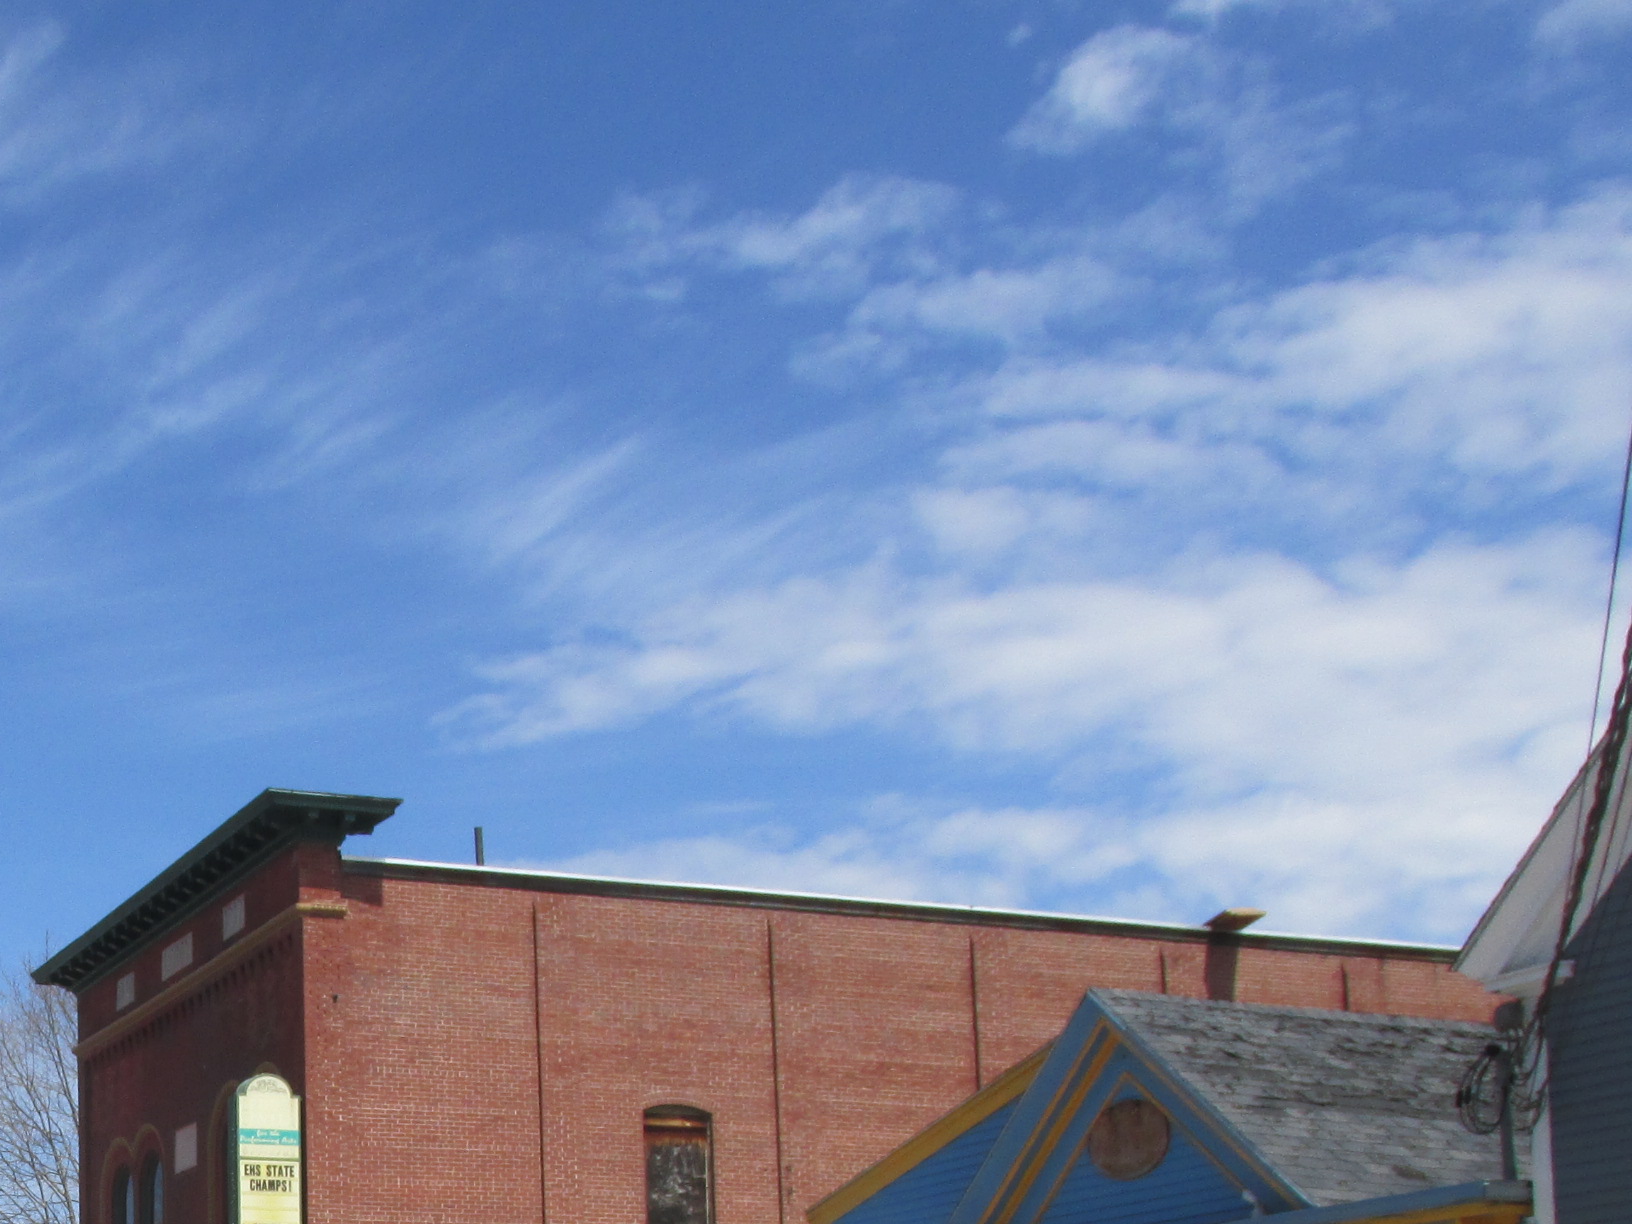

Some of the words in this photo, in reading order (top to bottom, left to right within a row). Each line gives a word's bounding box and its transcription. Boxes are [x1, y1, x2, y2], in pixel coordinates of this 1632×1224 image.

[244, 1164, 261, 1177] EHS
[266, 1165, 295, 1178] STATE
[249, 1179, 292, 1193] CHAMPS!
